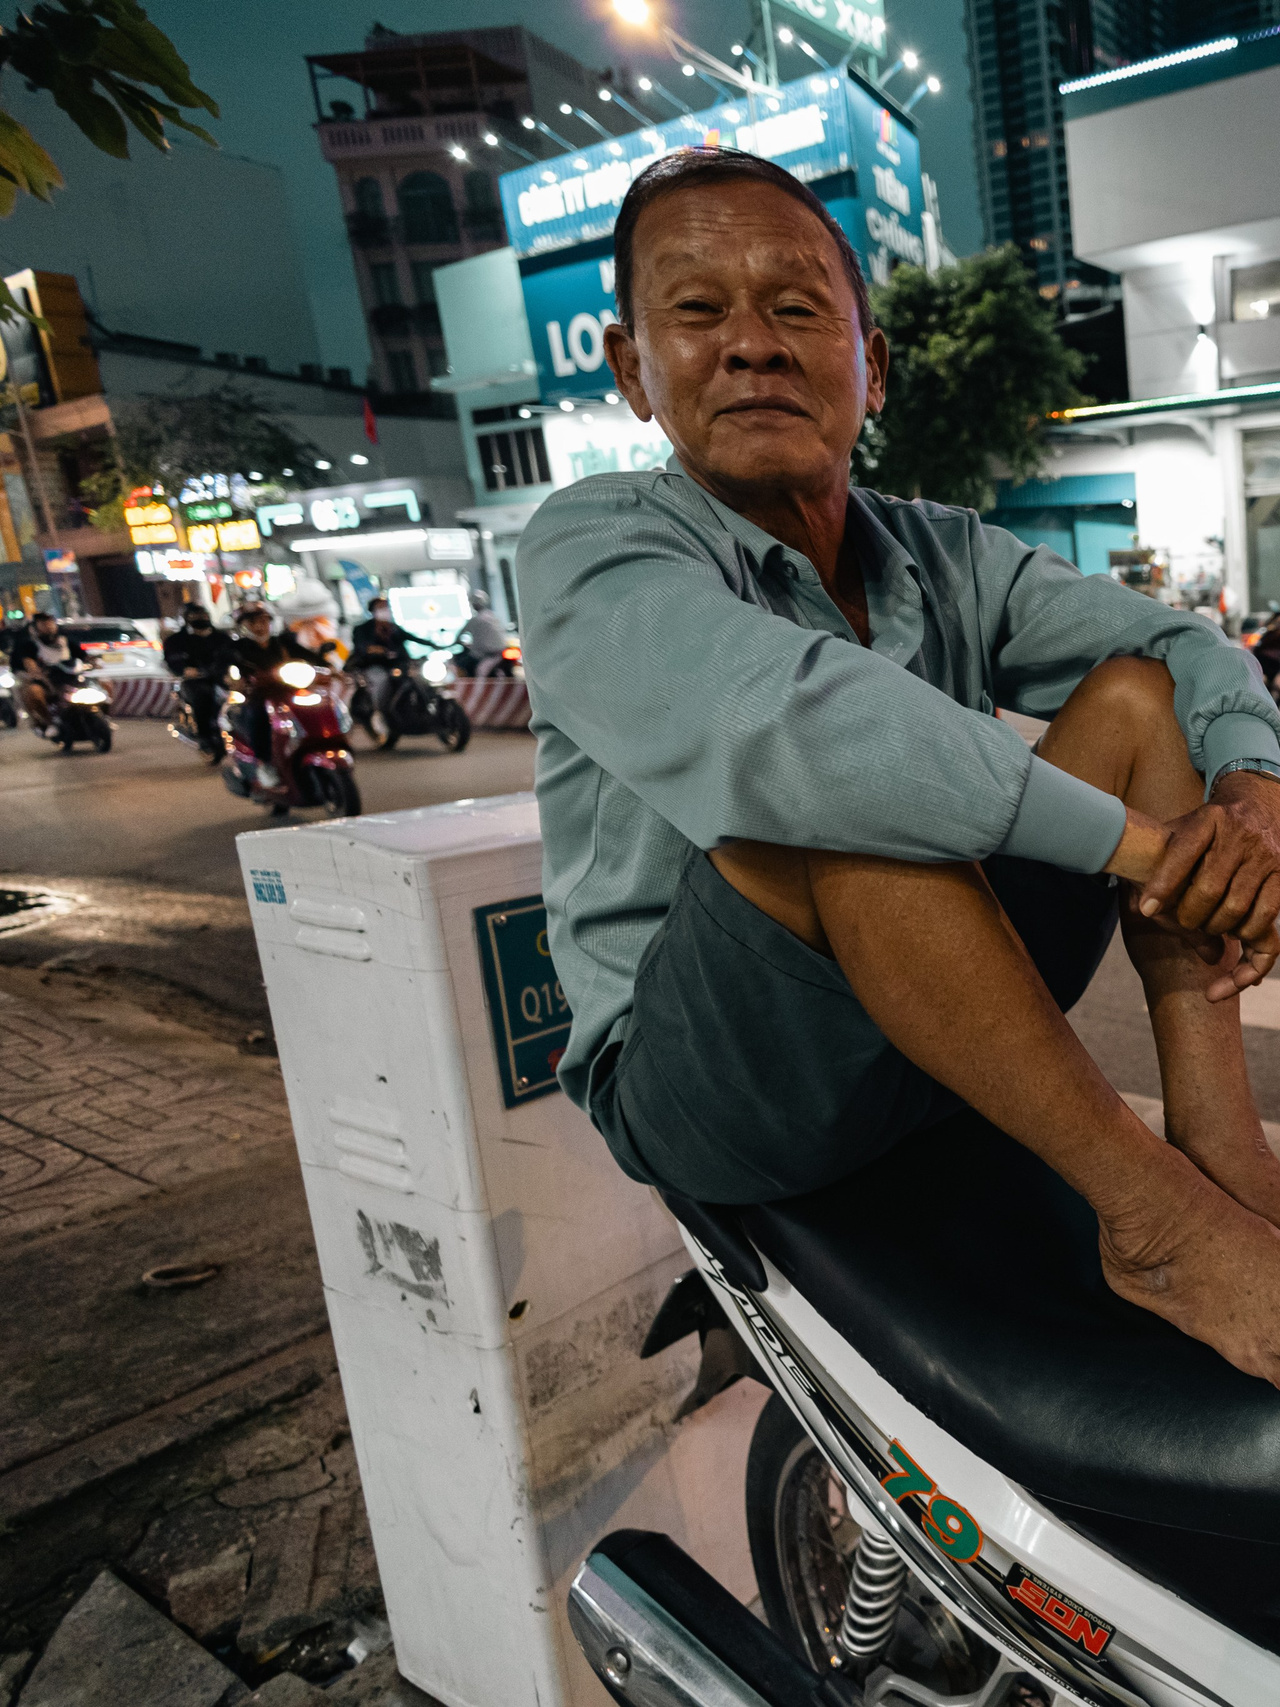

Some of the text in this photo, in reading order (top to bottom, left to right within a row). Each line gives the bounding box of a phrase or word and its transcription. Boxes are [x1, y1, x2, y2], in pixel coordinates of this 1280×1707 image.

[520, 979, 570, 1025] Q19
[692, 1234, 817, 1397] LADE
[880, 1438, 984, 1564] 79
[1016, 1576, 1110, 1657] NOS
[1063, 1595, 1084, 1613] OXIDE
[1084, 1611, 1113, 1633] NITROUS
[995, 1635, 1037, 1668] MODERN
[1039, 1667, 1081, 1696] ARTISTIC
